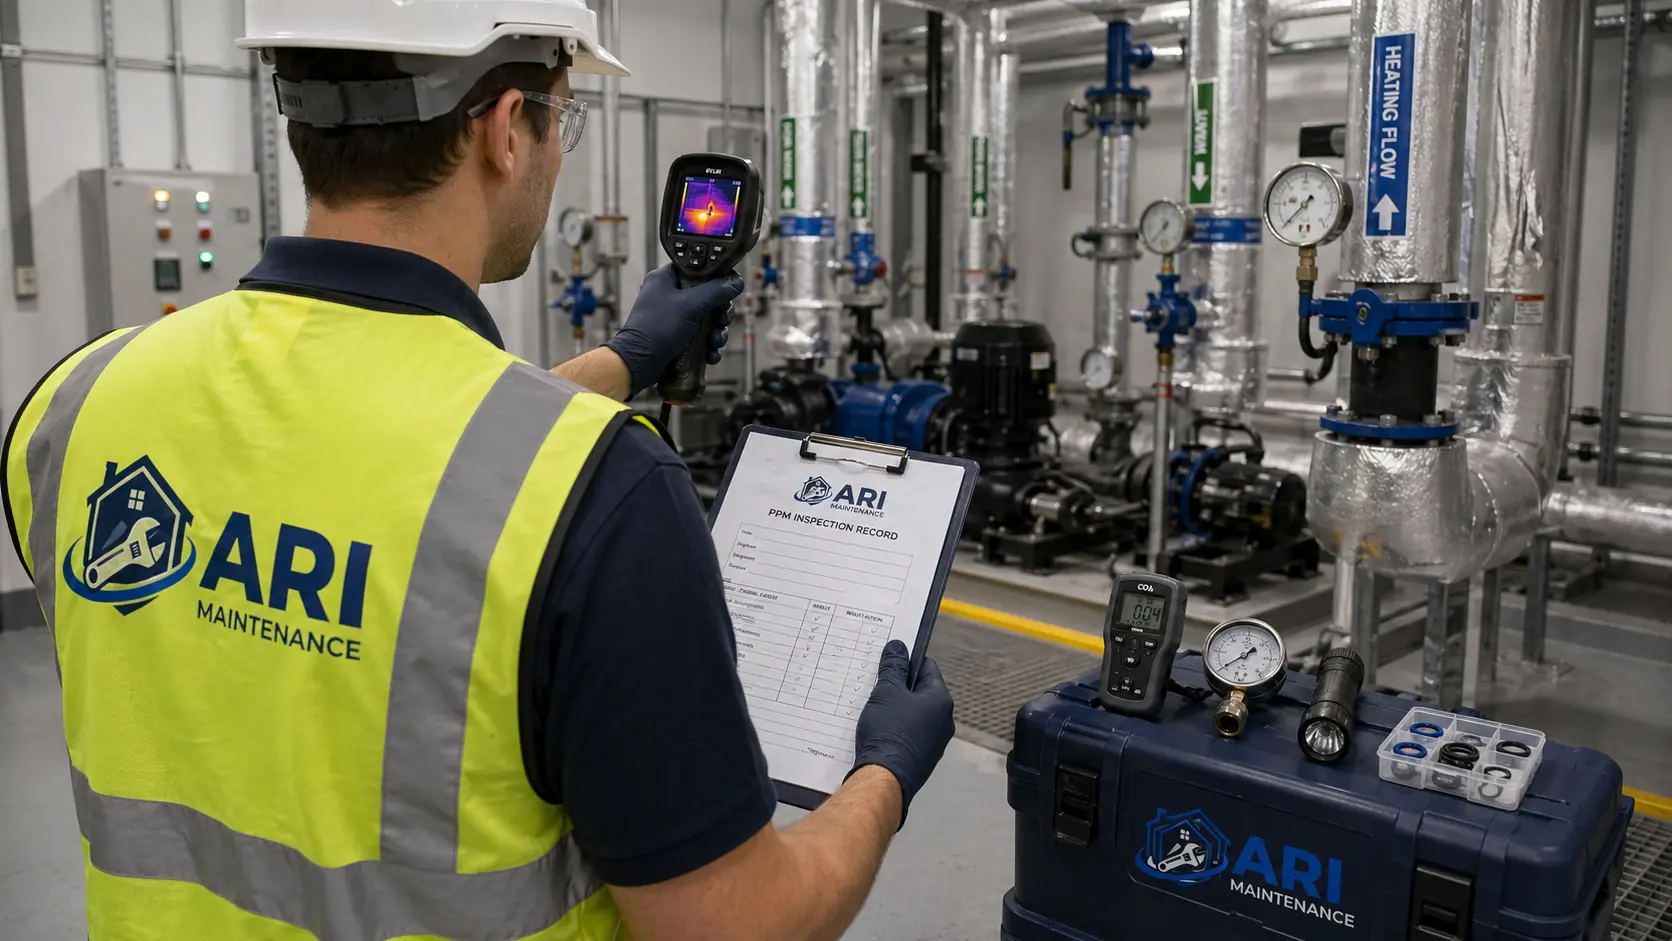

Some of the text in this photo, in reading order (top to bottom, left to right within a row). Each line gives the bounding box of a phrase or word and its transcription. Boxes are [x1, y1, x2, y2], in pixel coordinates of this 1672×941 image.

[1380, 45, 1402, 180] HEATING FLOW
[768, 508, 898, 541] PPM INSPECTION RECORD
[830, 503, 885, 518] MAINTENANCE
[832, 484, 887, 510] ARI
[199, 511, 373, 629] ARI
[197, 600, 362, 661] MAINTENANCE
[1231, 835, 1343, 905] ARI
[1230, 878, 1355, 928] MAINTENANCE
